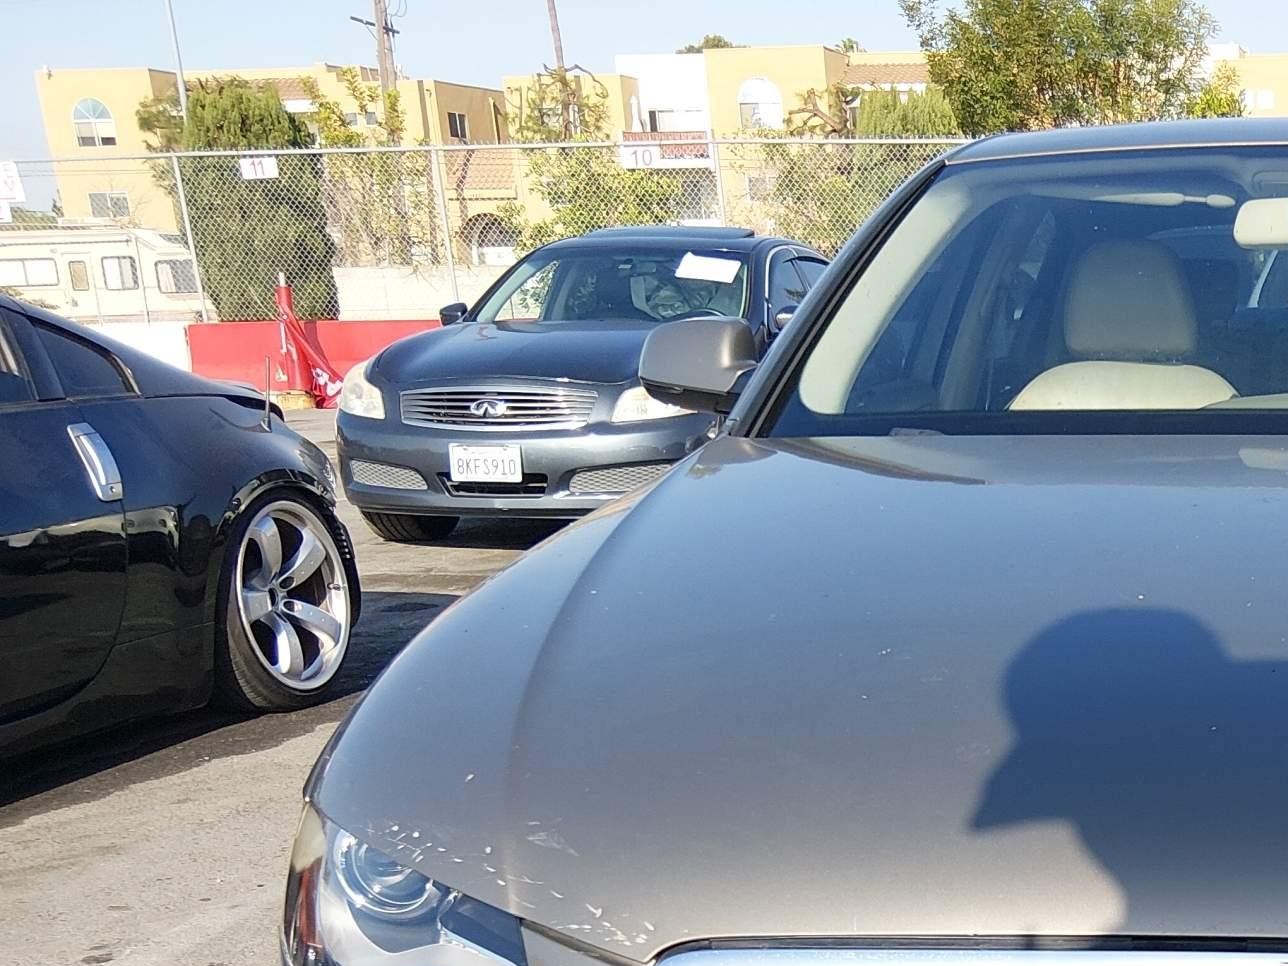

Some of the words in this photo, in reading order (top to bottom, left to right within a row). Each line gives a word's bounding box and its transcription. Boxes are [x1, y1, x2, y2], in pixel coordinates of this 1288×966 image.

[631, 149, 653, 167] 10
[250, 159, 265, 177] 11
[456, 458, 517, 476] 8KFS910
